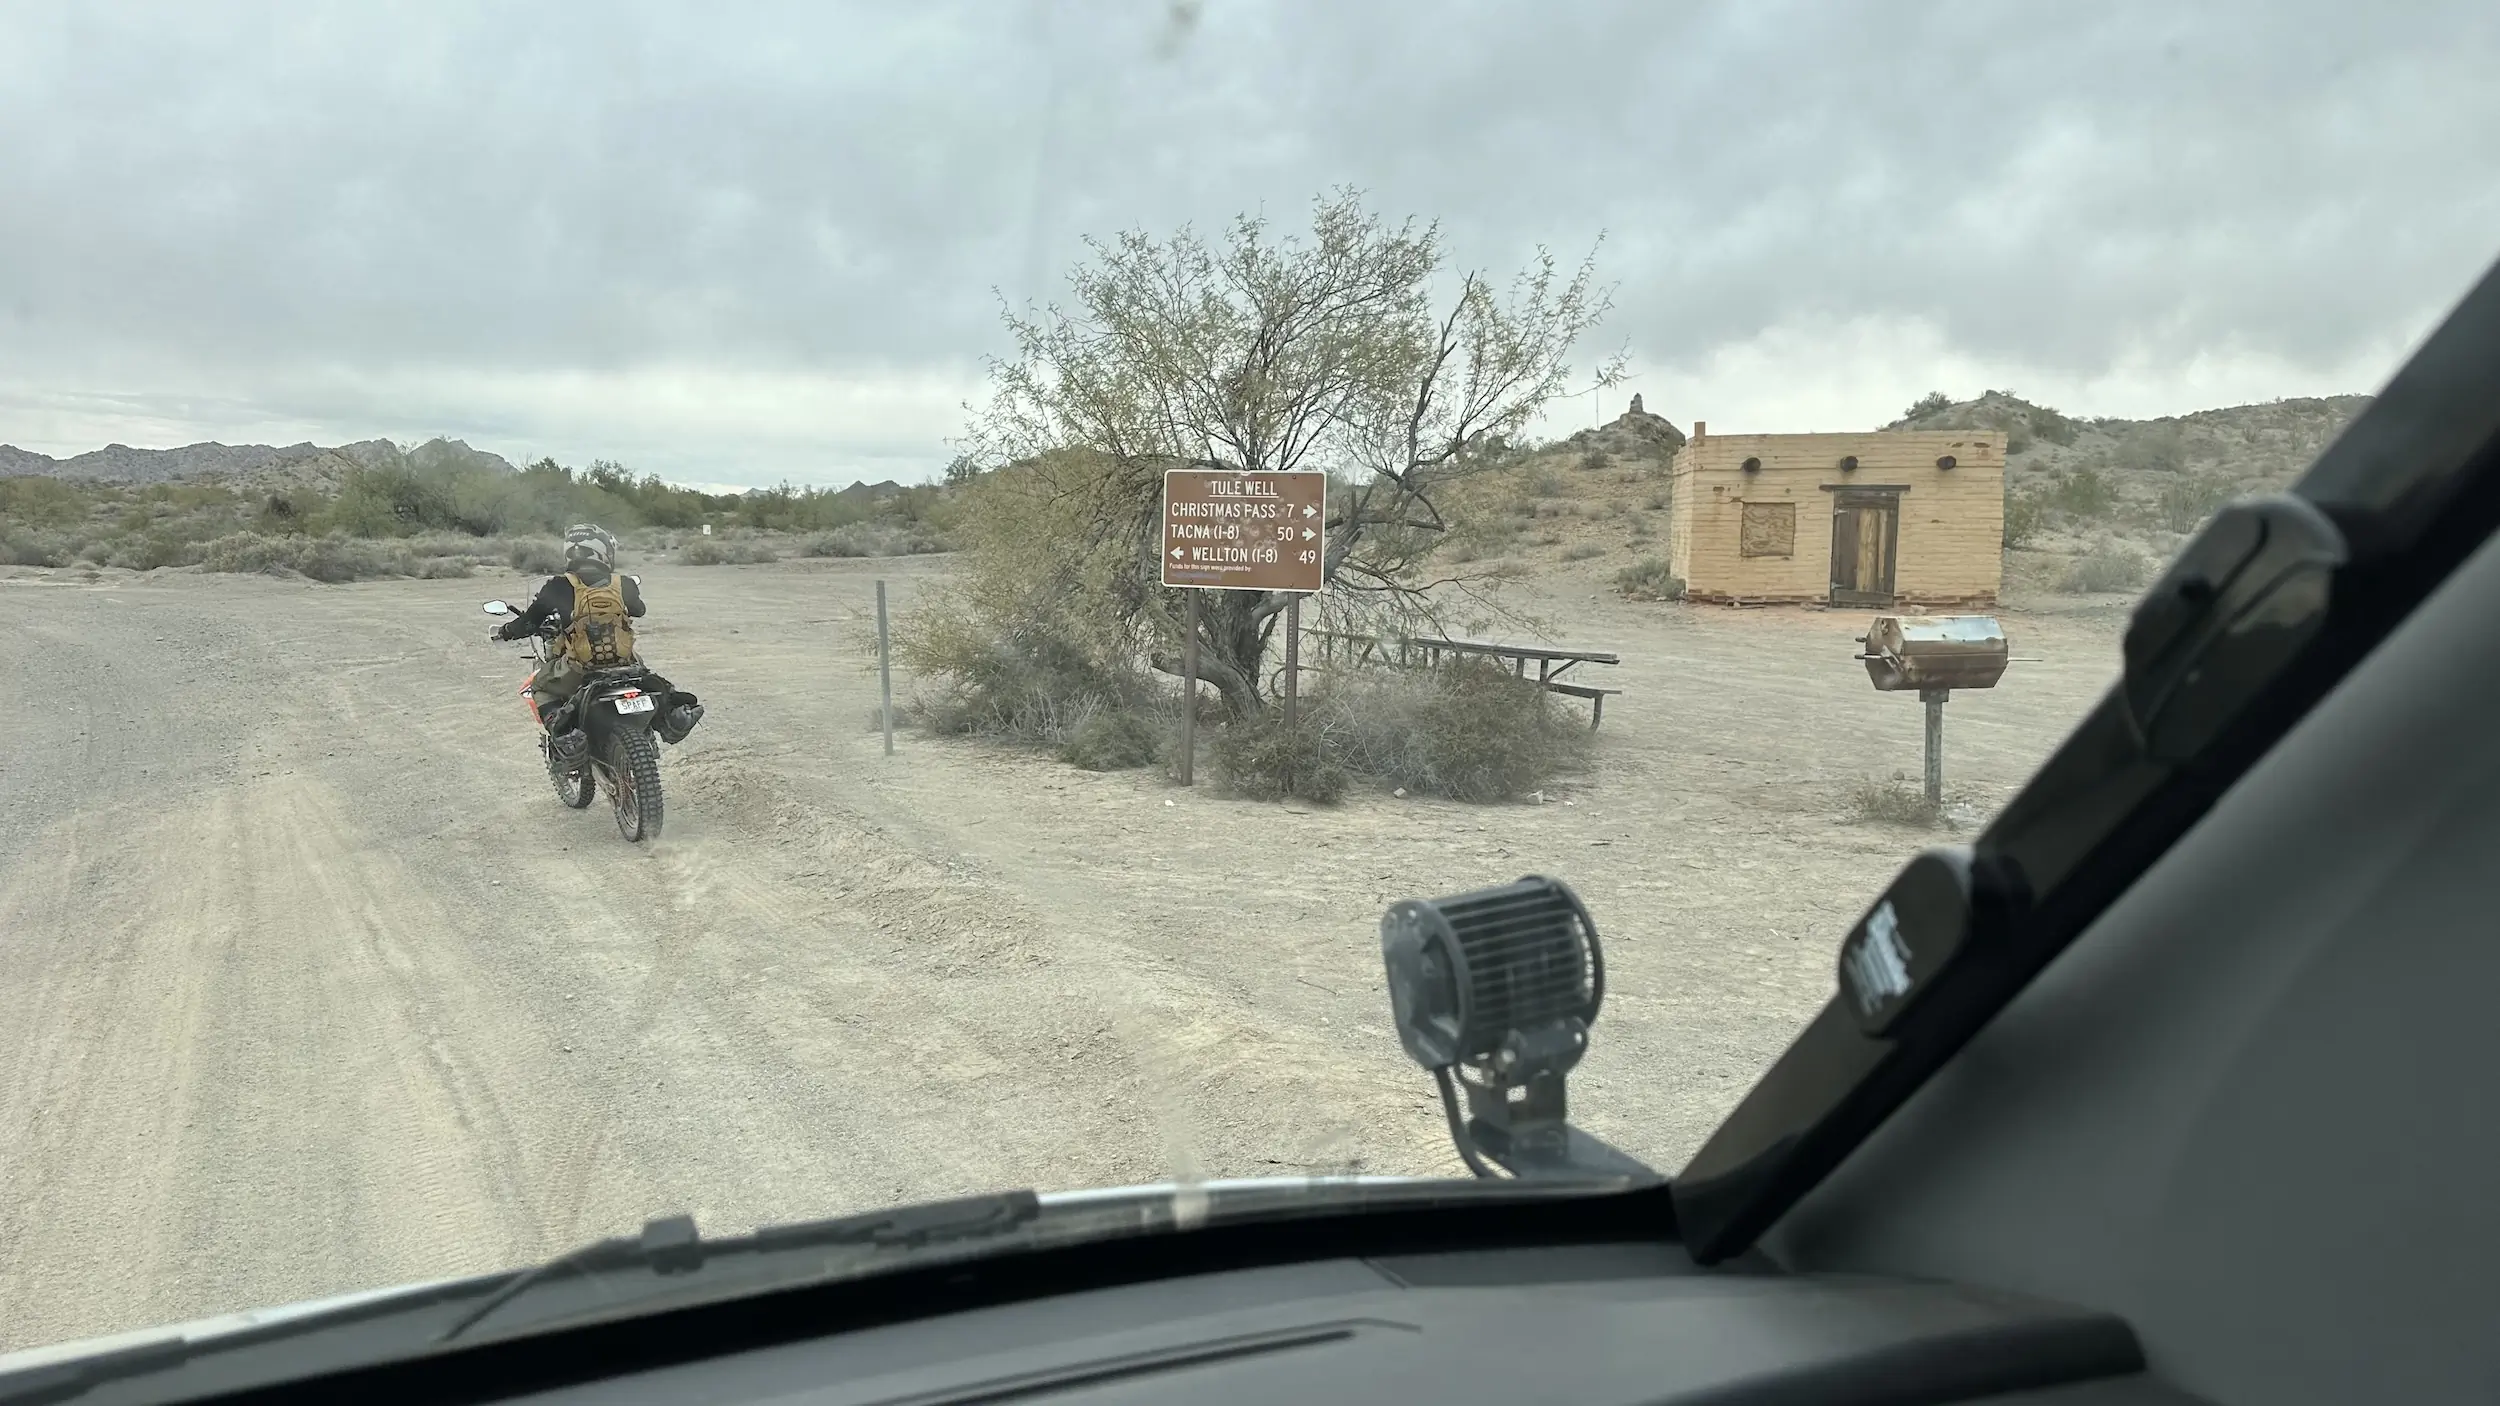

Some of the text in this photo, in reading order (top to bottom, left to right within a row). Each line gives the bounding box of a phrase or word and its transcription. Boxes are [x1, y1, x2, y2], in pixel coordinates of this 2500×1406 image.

[1211, 480, 1278, 496] TULE WELL
[1171, 502, 1295, 519] CHRISTMAS PASS 7
[1171, 524, 1294, 541] TACNA (I-8) 50
[1192, 546, 1316, 564] WELLTON (I-8) 49
[1200, 564, 1210, 572] sign
